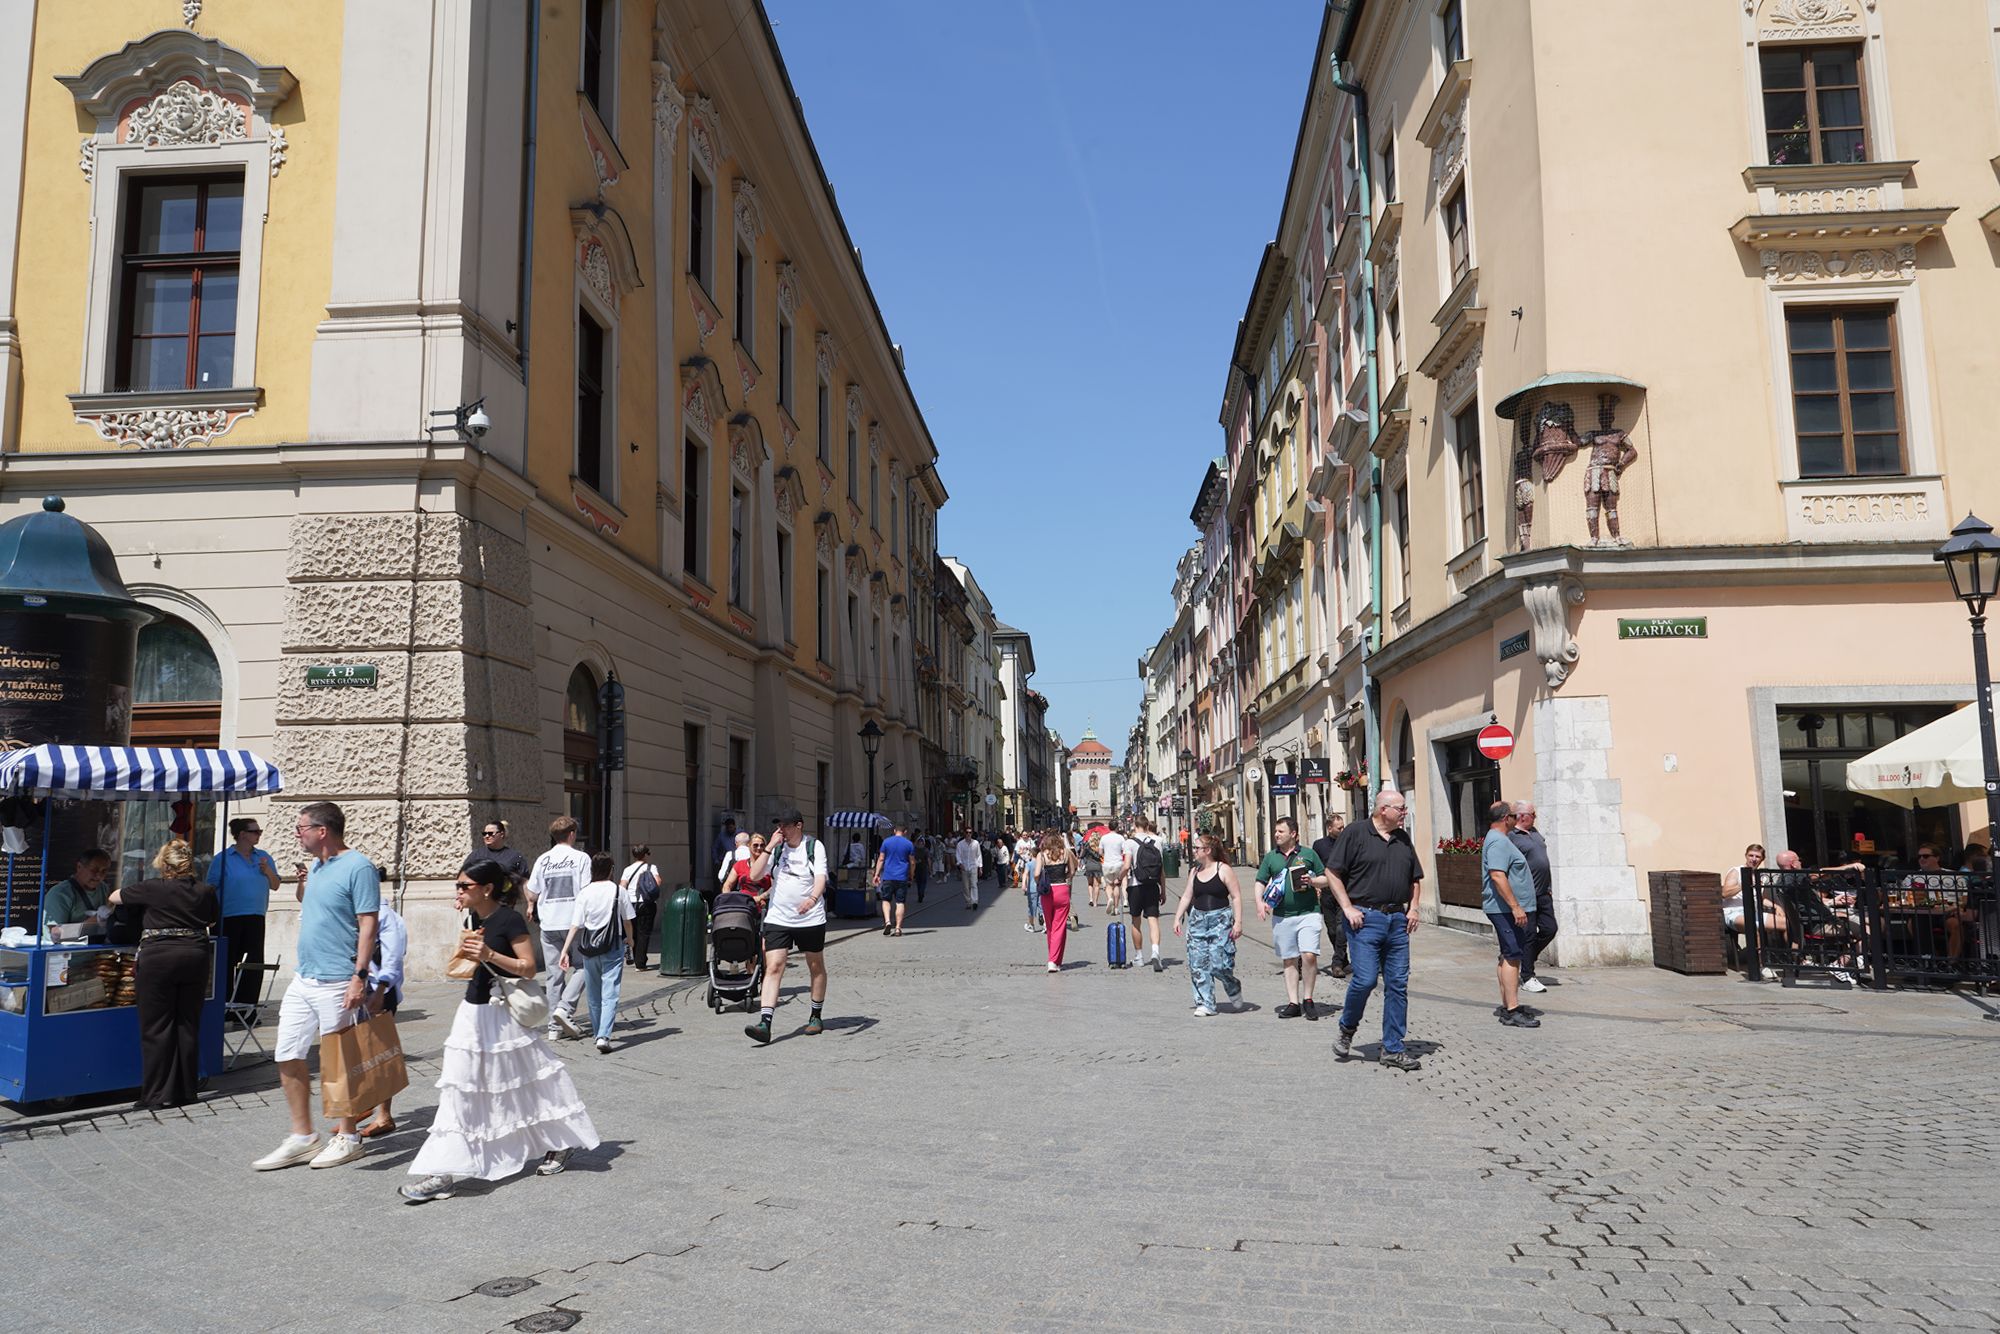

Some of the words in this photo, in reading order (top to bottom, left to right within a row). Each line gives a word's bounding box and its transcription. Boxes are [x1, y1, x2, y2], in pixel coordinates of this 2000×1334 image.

[1627, 624, 1700, 637] MARIACKI
[0, 656, 60, 670] akowie
[6, 681, 64, 690] TEATRALNE
[7, 691, 64, 700] 2026/2027
[540, 855, 578, 878] Fender
